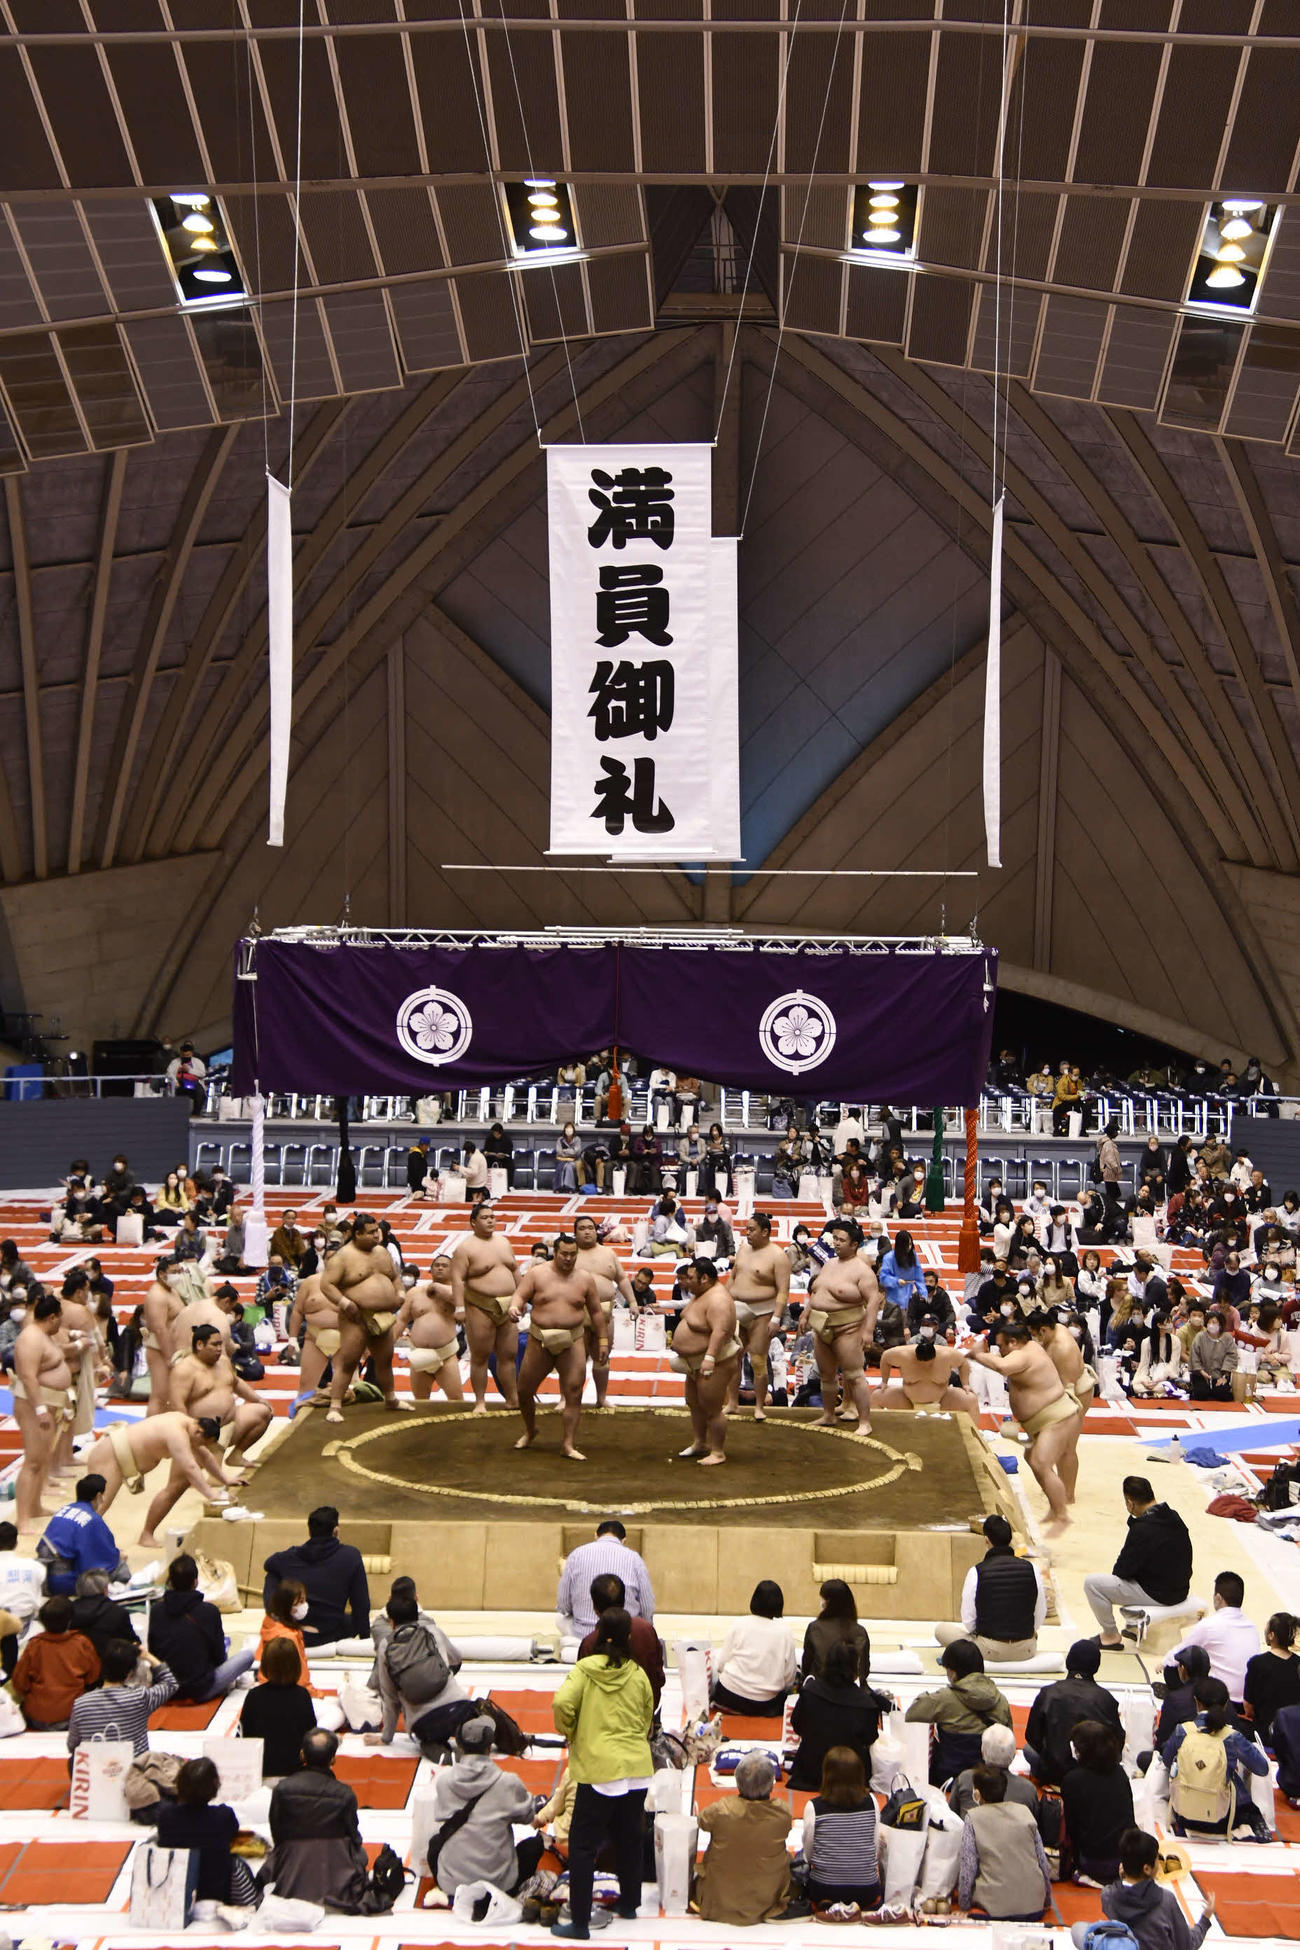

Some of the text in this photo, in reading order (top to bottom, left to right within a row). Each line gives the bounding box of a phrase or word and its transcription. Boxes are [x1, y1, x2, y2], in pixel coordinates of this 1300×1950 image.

[587, 466, 675, 836] 満員御礼
[635, 1318, 646, 1351] KIRIN
[72, 1751, 90, 1820] KIRIN
